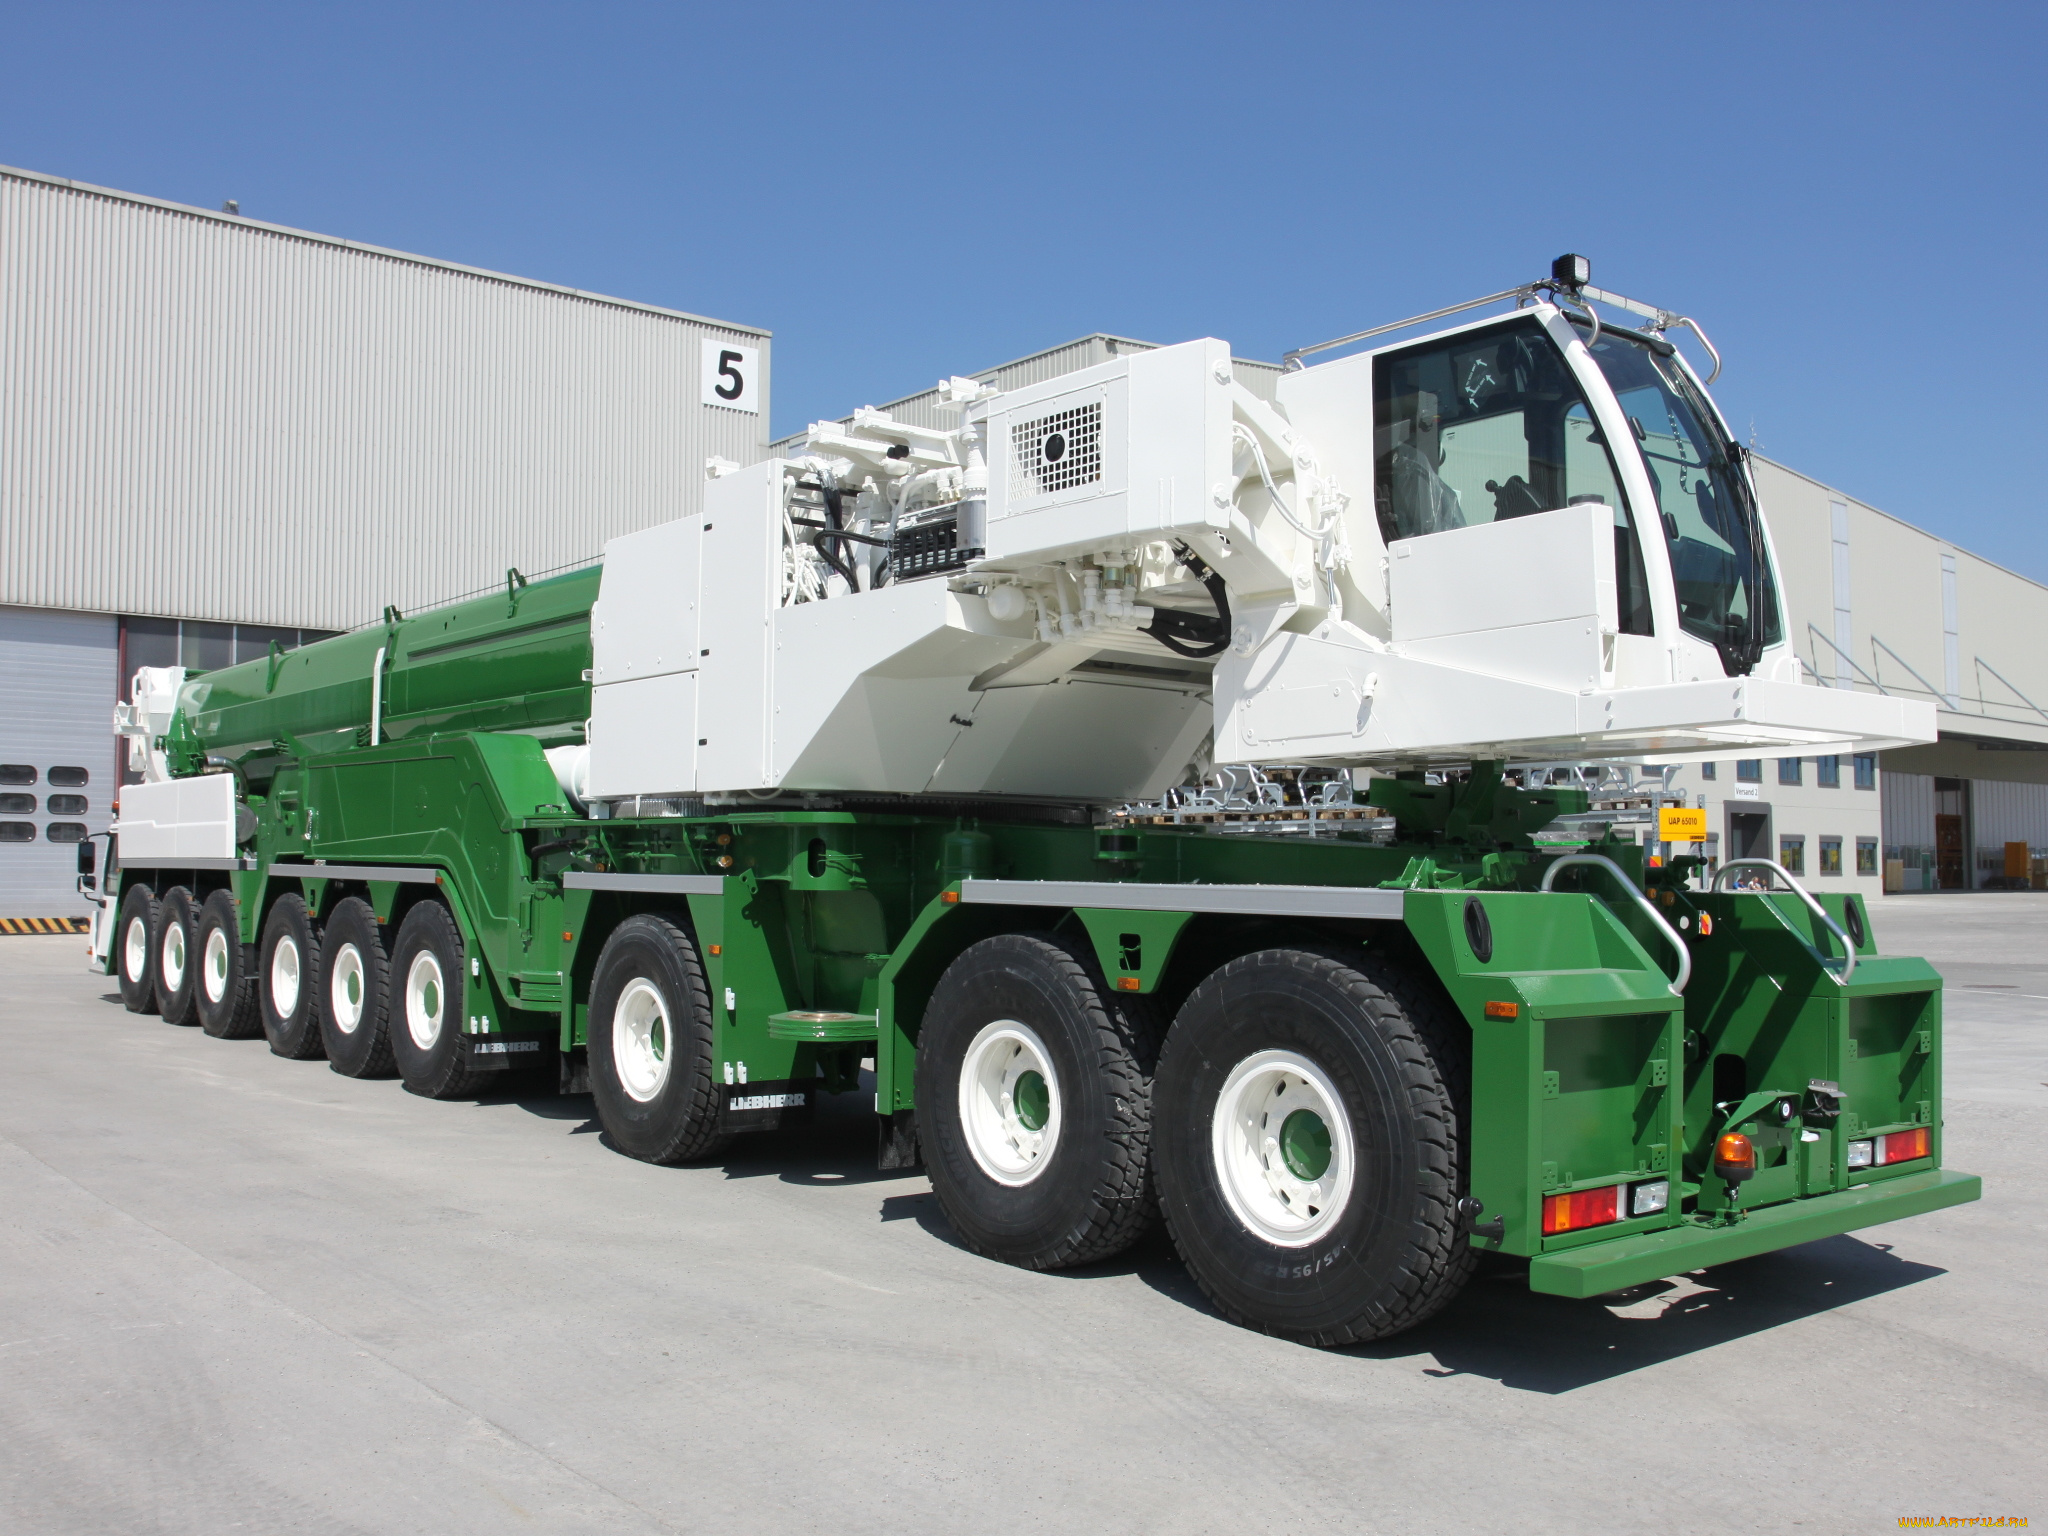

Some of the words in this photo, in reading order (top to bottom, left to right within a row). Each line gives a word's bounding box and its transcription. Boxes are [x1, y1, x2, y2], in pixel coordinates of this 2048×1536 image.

[715, 350, 743, 400] 5
[1736, 787, 1754, 796] Versand
[1668, 817, 1680, 825] UAP
[1682, 817, 1697, 825] 65010
[475, 1041, 539, 1053] LIEBHERR
[730, 1093, 805, 1110] LIEBHERR
